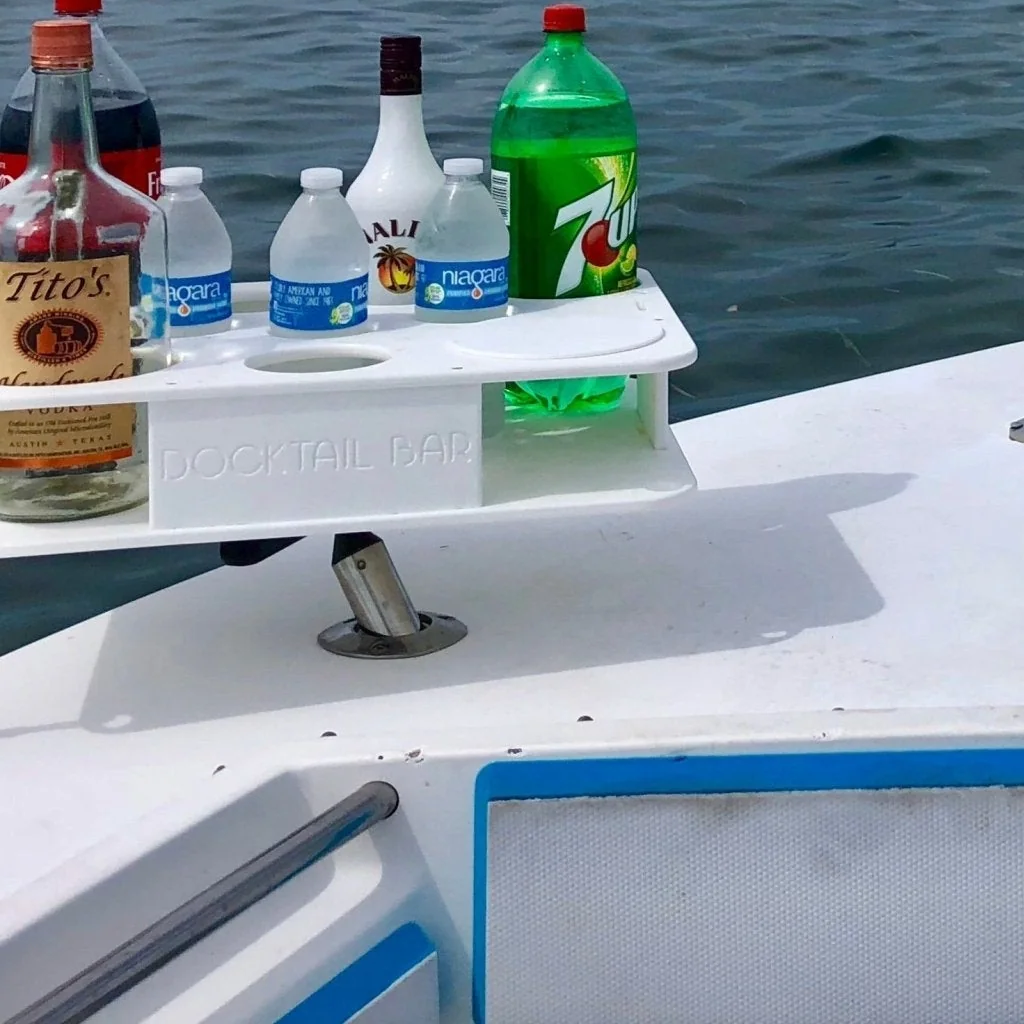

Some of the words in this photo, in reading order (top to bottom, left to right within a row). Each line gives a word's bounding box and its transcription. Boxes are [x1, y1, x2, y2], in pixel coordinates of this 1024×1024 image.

[442, 266, 505, 291] niagara
[9, 440, 48, 448] AUSTIN
[73, 435, 112, 445] TEXAS
[162, 438, 374, 481] DOCKTAIL
[391, 432, 473, 468] BAR
